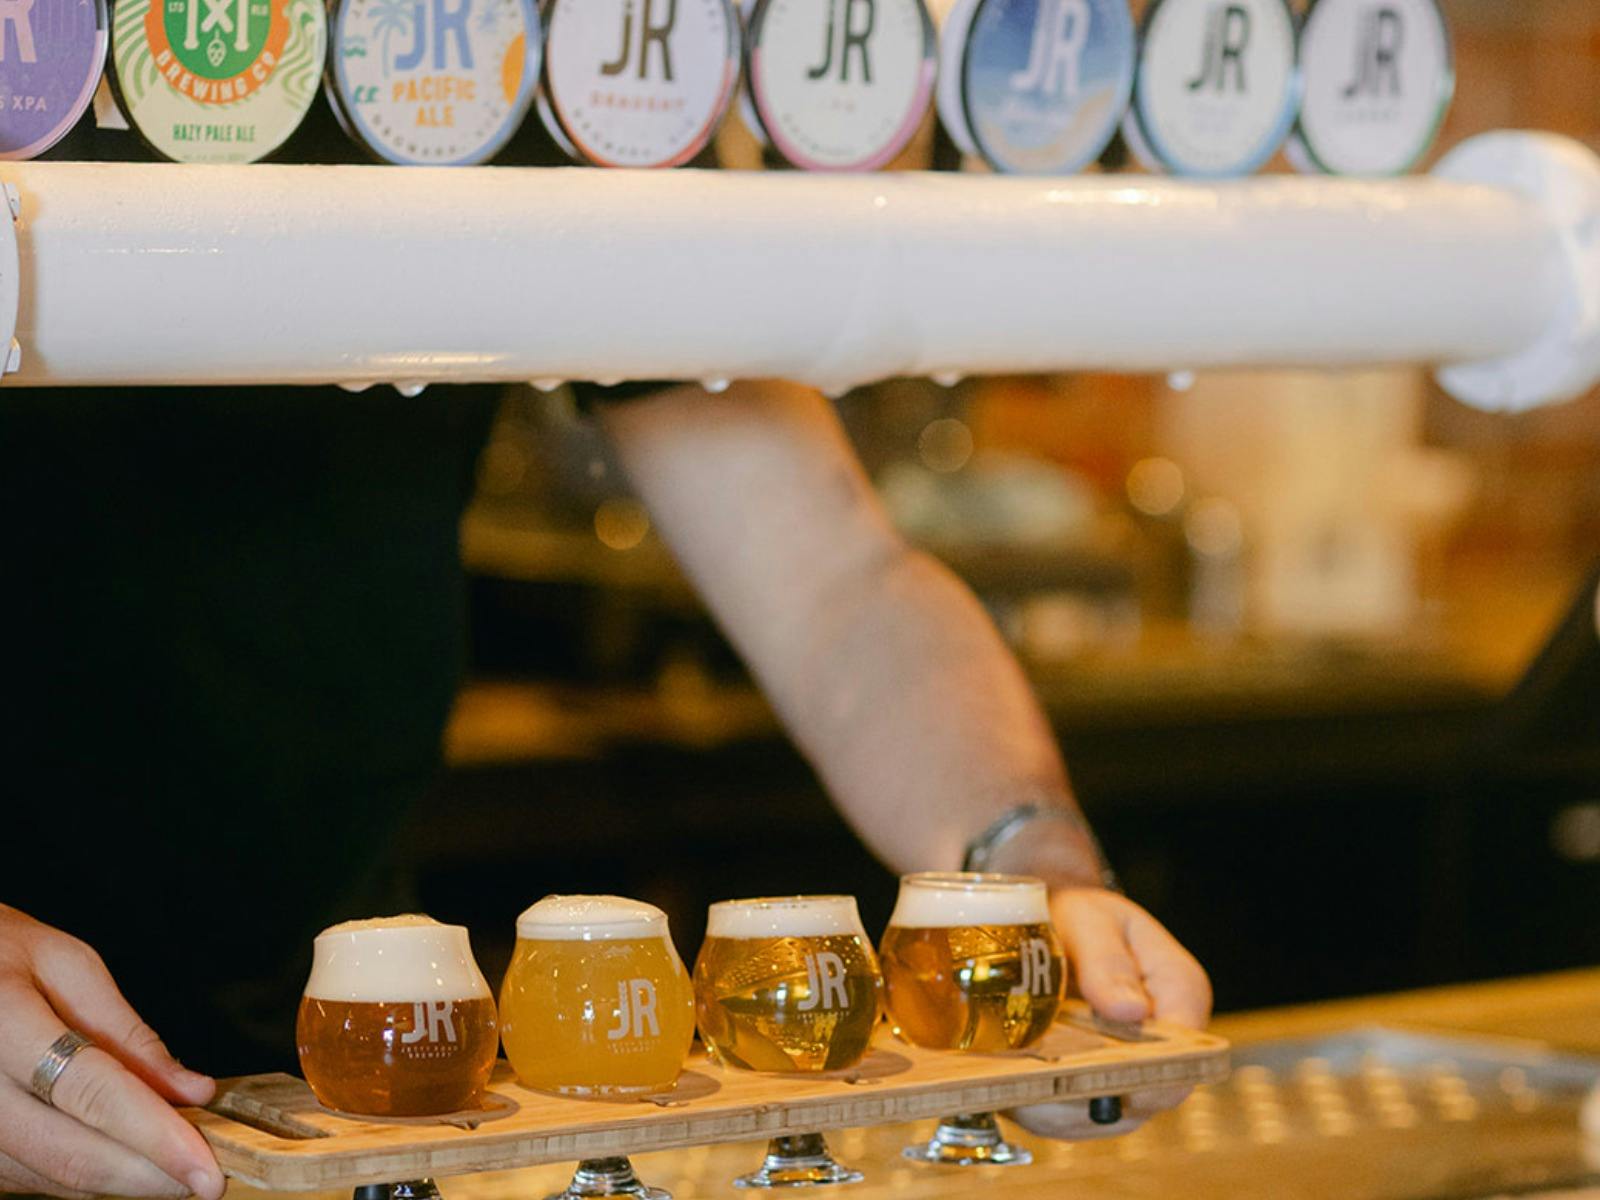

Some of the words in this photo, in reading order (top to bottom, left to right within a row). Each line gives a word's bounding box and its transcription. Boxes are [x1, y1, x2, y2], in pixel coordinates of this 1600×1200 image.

[394, 0, 475, 70] JR
[600, 0, 674, 82] JR
[807, 0, 872, 83] JR
[1008, 0, 1091, 95] JR
[1185, 4, 1250, 94] JR
[12, 96, 47, 112] XPA
[155, 49, 248, 101] BREWING
[391, 75, 476, 103] PACIFIC
[172, 124, 201, 142] HAZY
[205, 125, 233, 142] PALE
[235, 125, 256, 142] ALE
[414, 106, 455, 128] ALE
[797, 952, 849, 1011] JR
[1010, 937, 1052, 997] JR
[401, 1001, 457, 1044] JR
[607, 978, 661, 1040] JR
